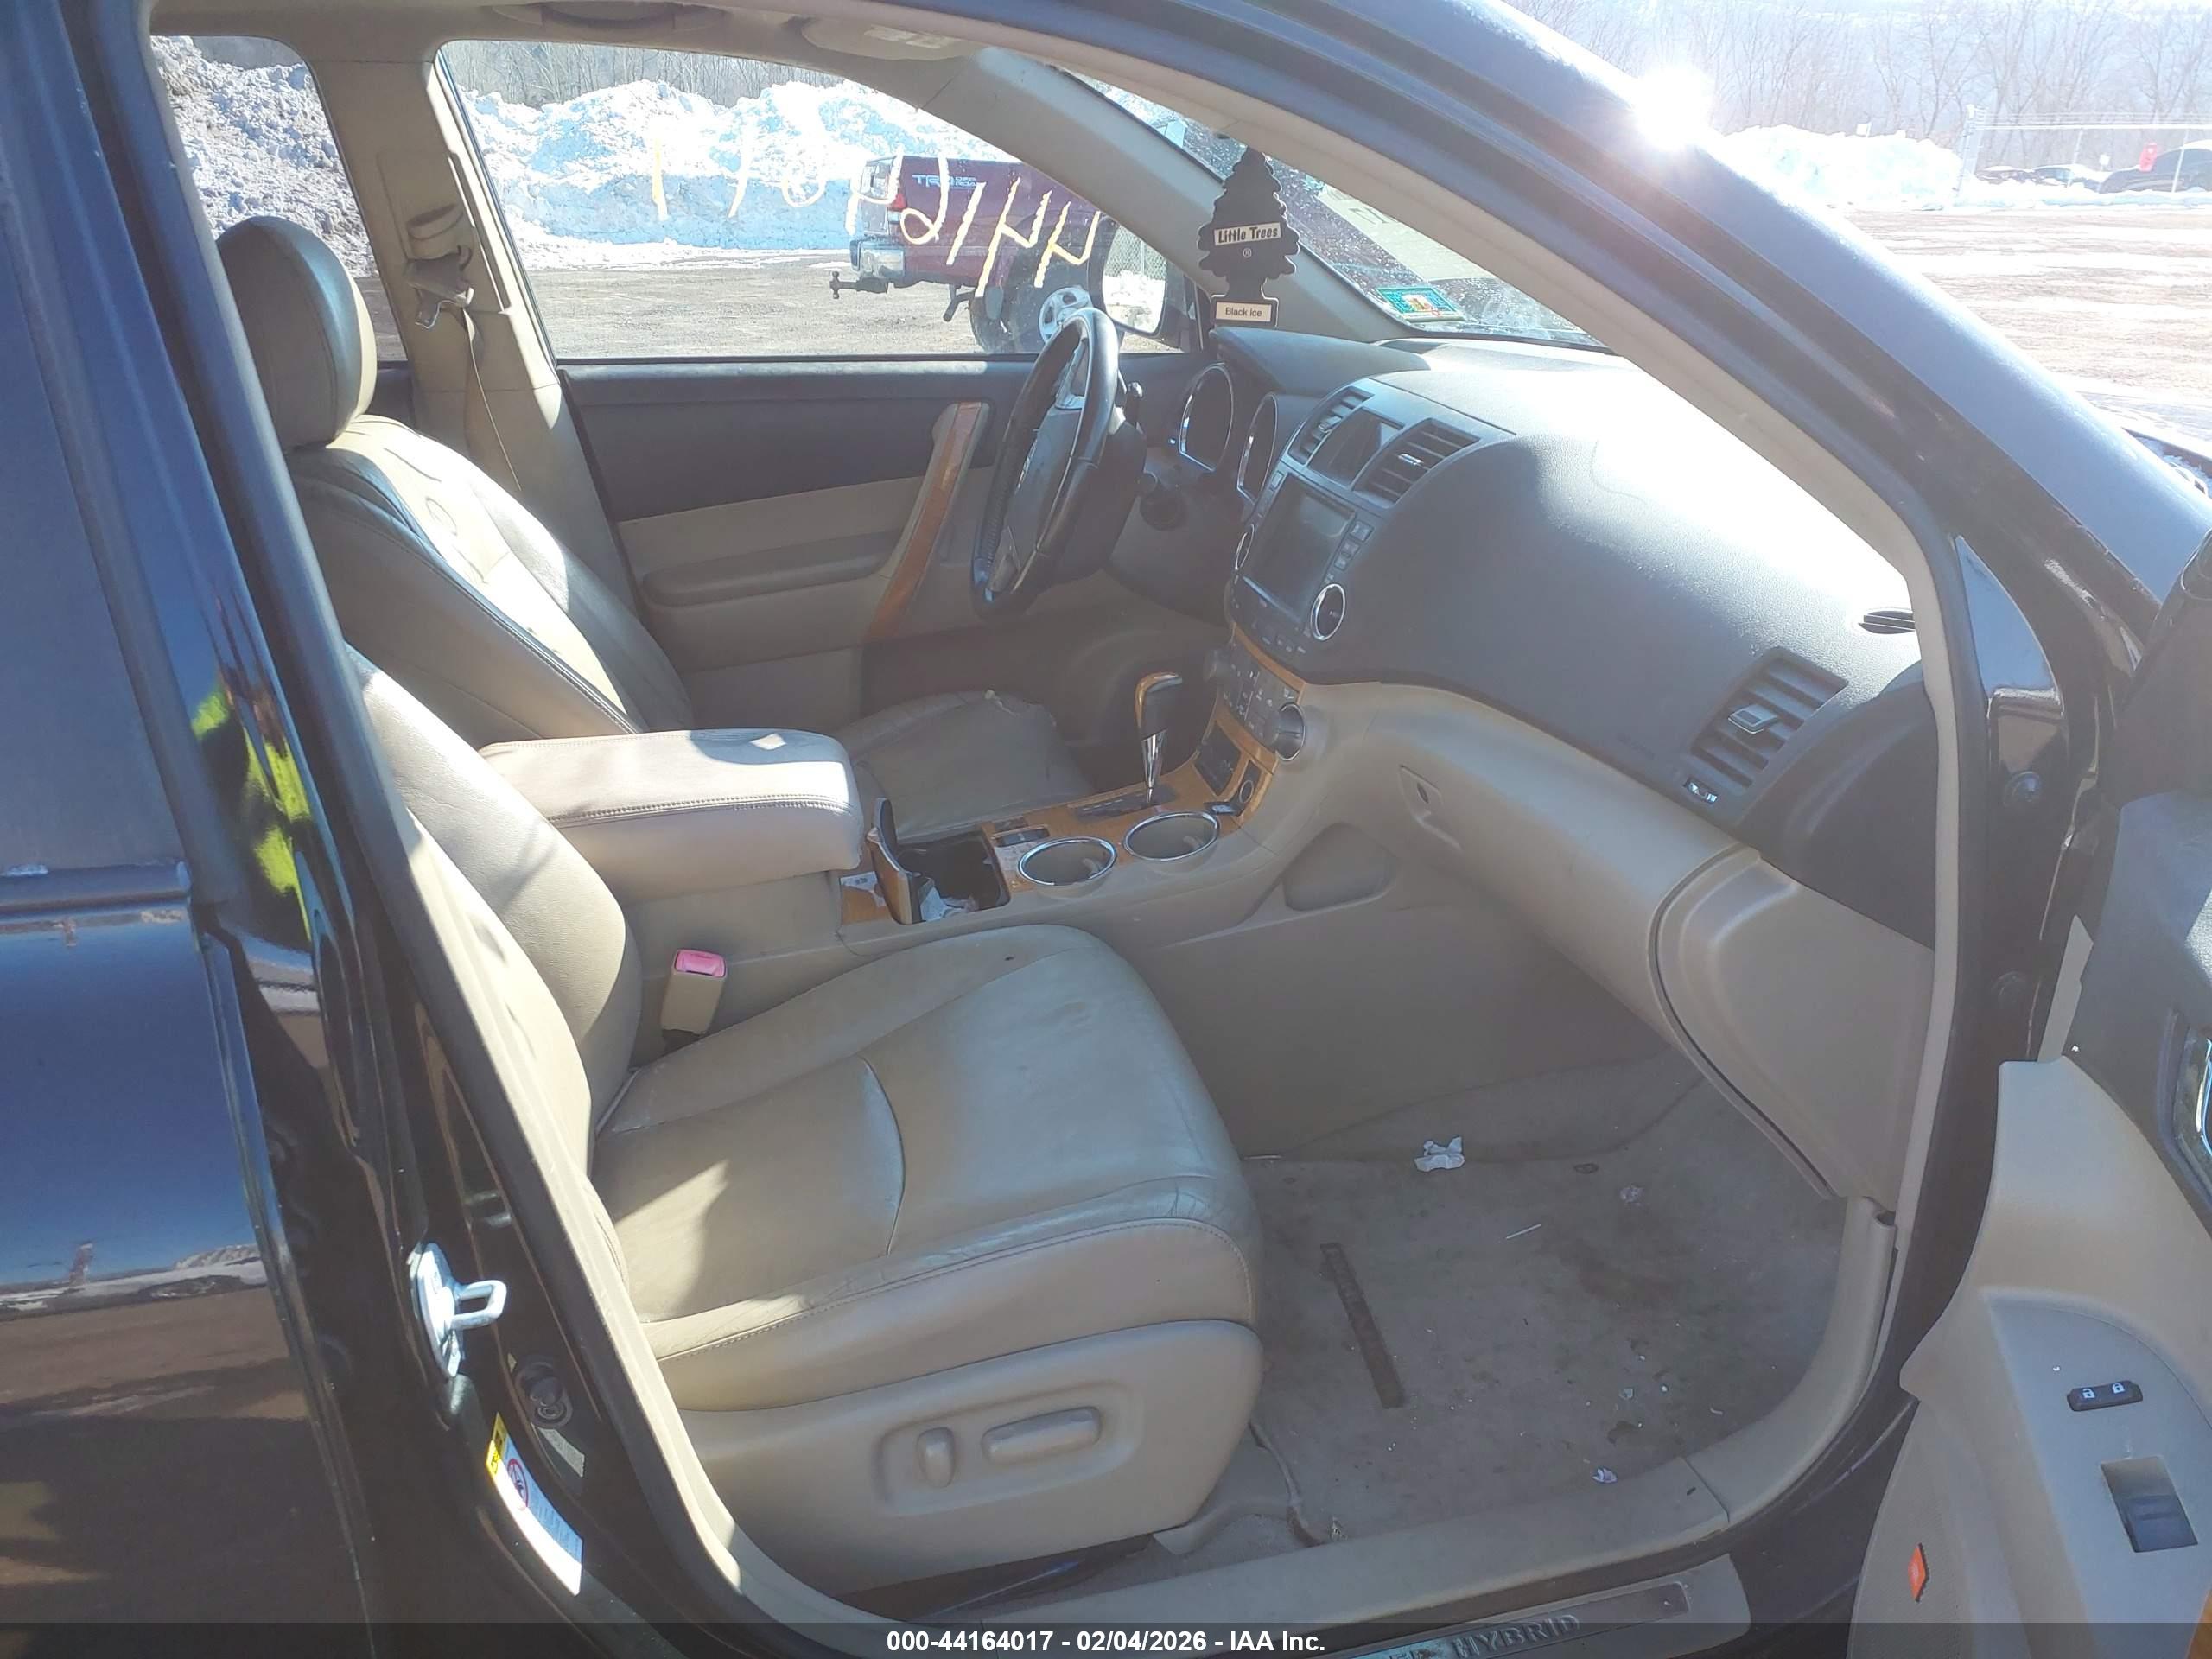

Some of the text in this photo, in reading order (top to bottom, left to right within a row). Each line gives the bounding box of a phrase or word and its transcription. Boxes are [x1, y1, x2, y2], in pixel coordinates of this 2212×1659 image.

[1218, 226, 1278, 243] Little Trees
[1225, 307, 1248, 316] Black
[1452, 1613, 1581, 1659] HYBRID
